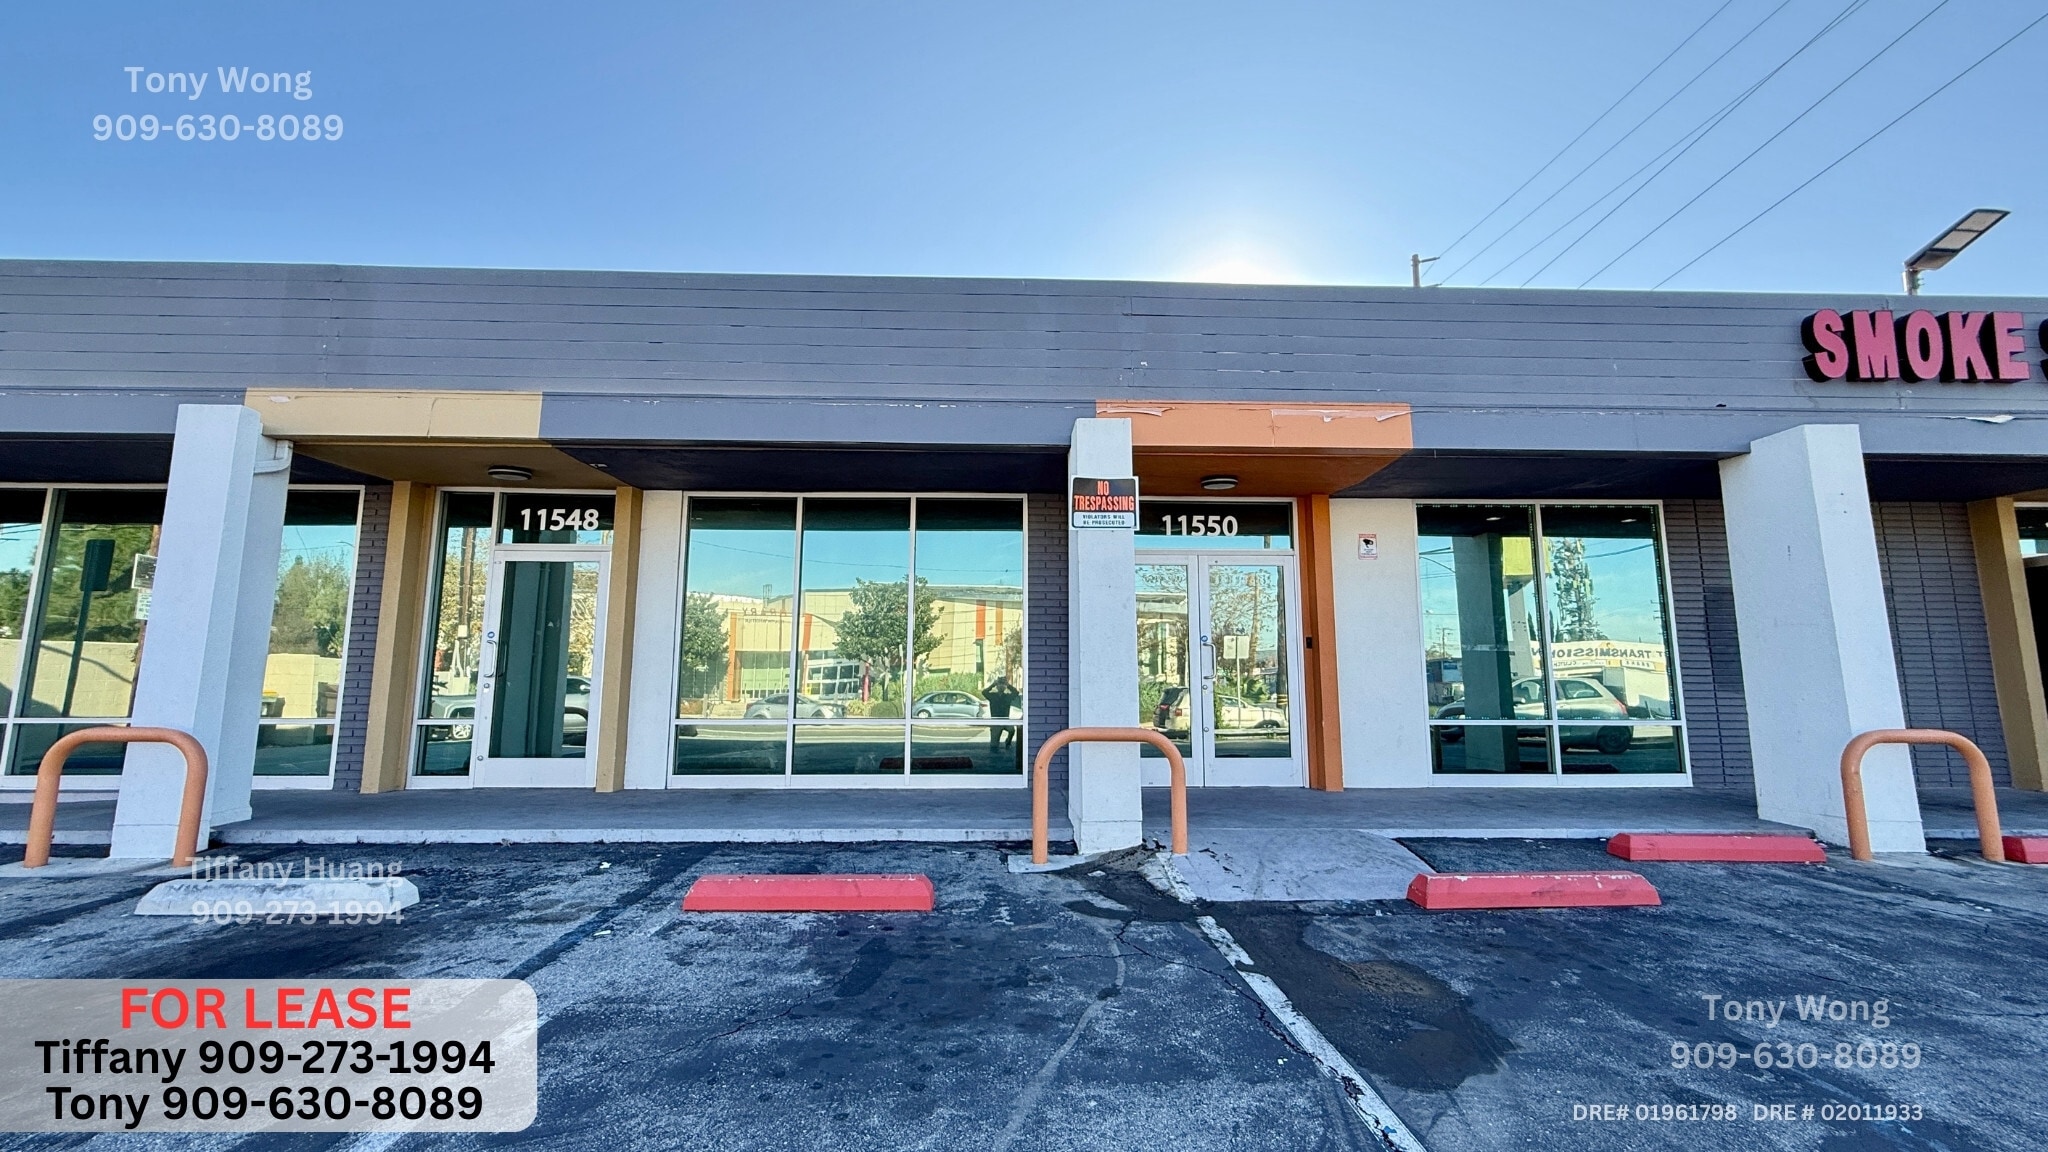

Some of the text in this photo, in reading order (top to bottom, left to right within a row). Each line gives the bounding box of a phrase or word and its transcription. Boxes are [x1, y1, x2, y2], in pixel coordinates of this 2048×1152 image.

[1803, 308, 2030, 382] SMOKE
[1097, 480, 1110, 496] NO
[1073, 495, 1135, 511] TRESPASSING
[521, 508, 599, 531] 11548
[1161, 514, 1239, 537] 11550
